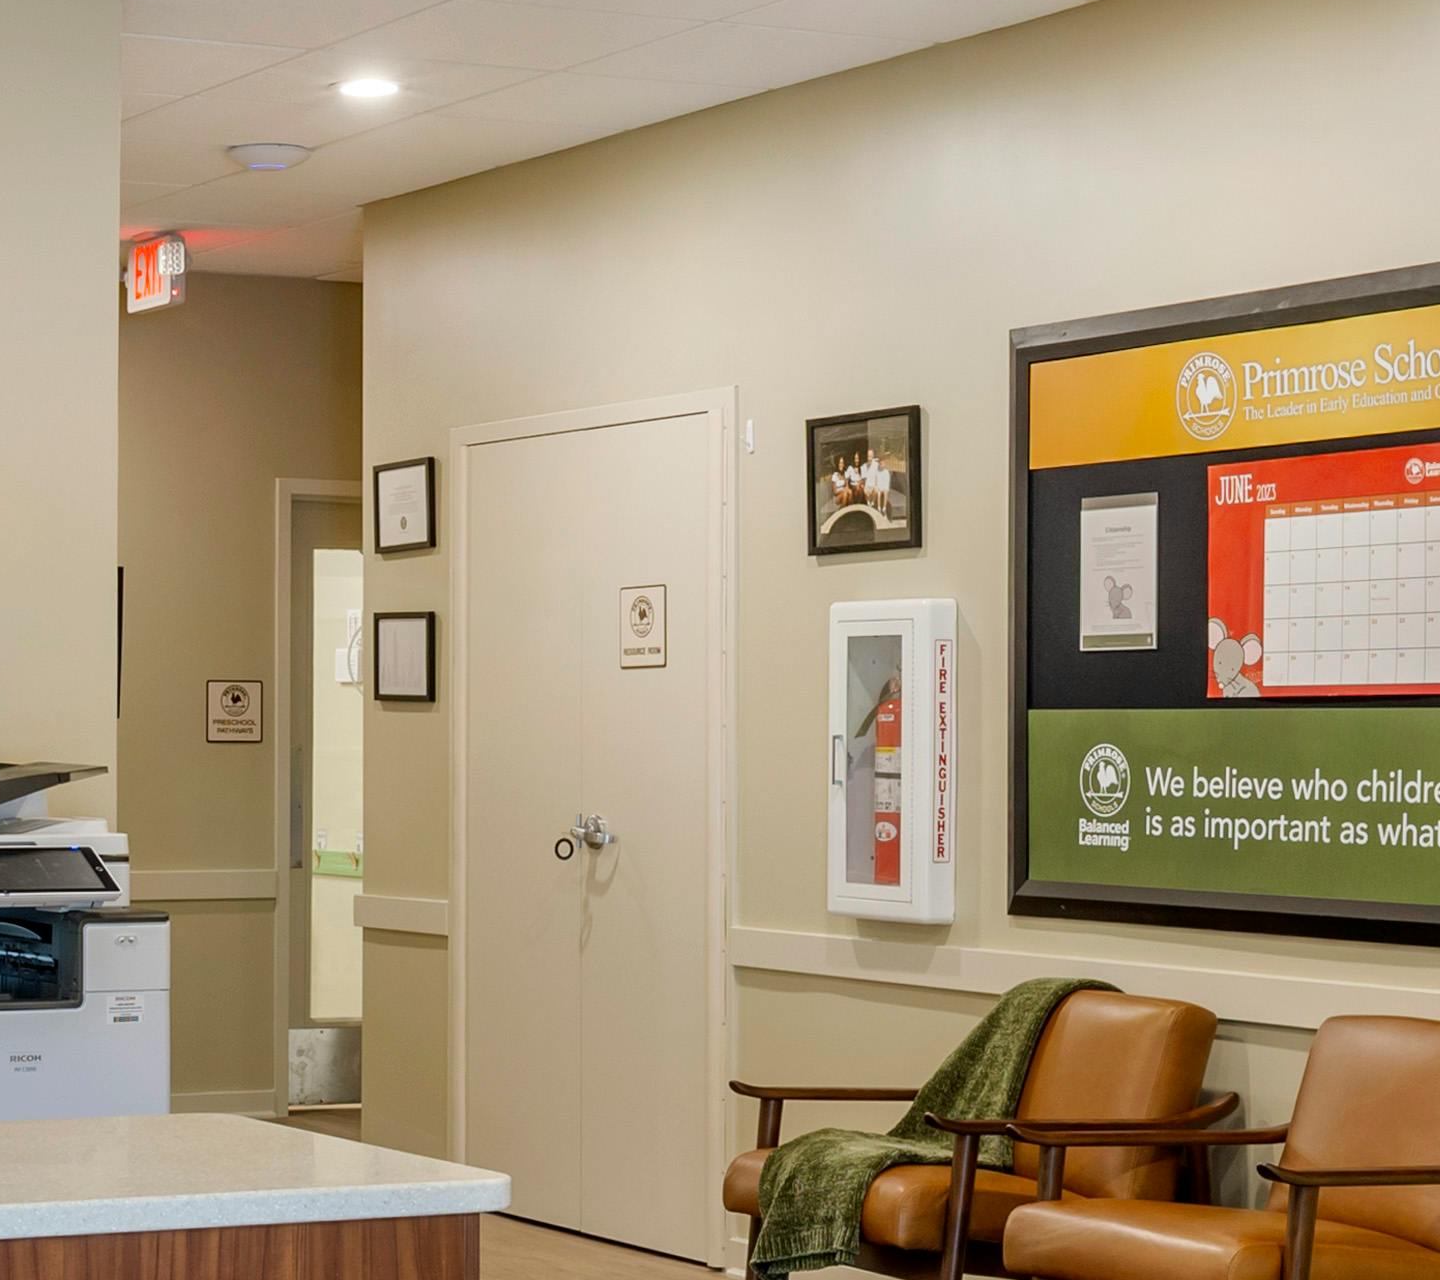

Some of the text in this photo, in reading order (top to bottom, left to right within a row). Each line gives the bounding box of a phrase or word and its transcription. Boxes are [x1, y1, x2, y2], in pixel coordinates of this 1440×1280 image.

[1181, 355, 1230, 387] PRIMROSE
[1242, 357, 1367, 400] Primrose
[1243, 406, 1264, 420] The
[1267, 402, 1304, 418] Leader
[1306, 401, 1317, 415] in
[1320, 397, 1348, 416] Early
[1352, 387, 1408, 409] Education
[1411, 386, 1432, 403] and
[1191, 422, 1224, 436] SCHOOLS
[1216, 474, 1276, 505] JUNE 2023
[1084, 747, 1127, 772] PRIMROSE
[937, 702, 947, 858] EXTINGUISHER
[1145, 767, 1185, 798] We
[1192, 766, 1284, 801] believe
[1291, 768, 1348, 802] who
[1079, 818, 1130, 834] Balanced
[1079, 832, 1130, 851] Learning
[1144, 807, 1163, 837] is
[1170, 814, 1195, 838] as
[1204, 808, 1331, 850] important
[1339, 820, 1369, 845] as
[9, 1054, 42, 1062] RICOH
